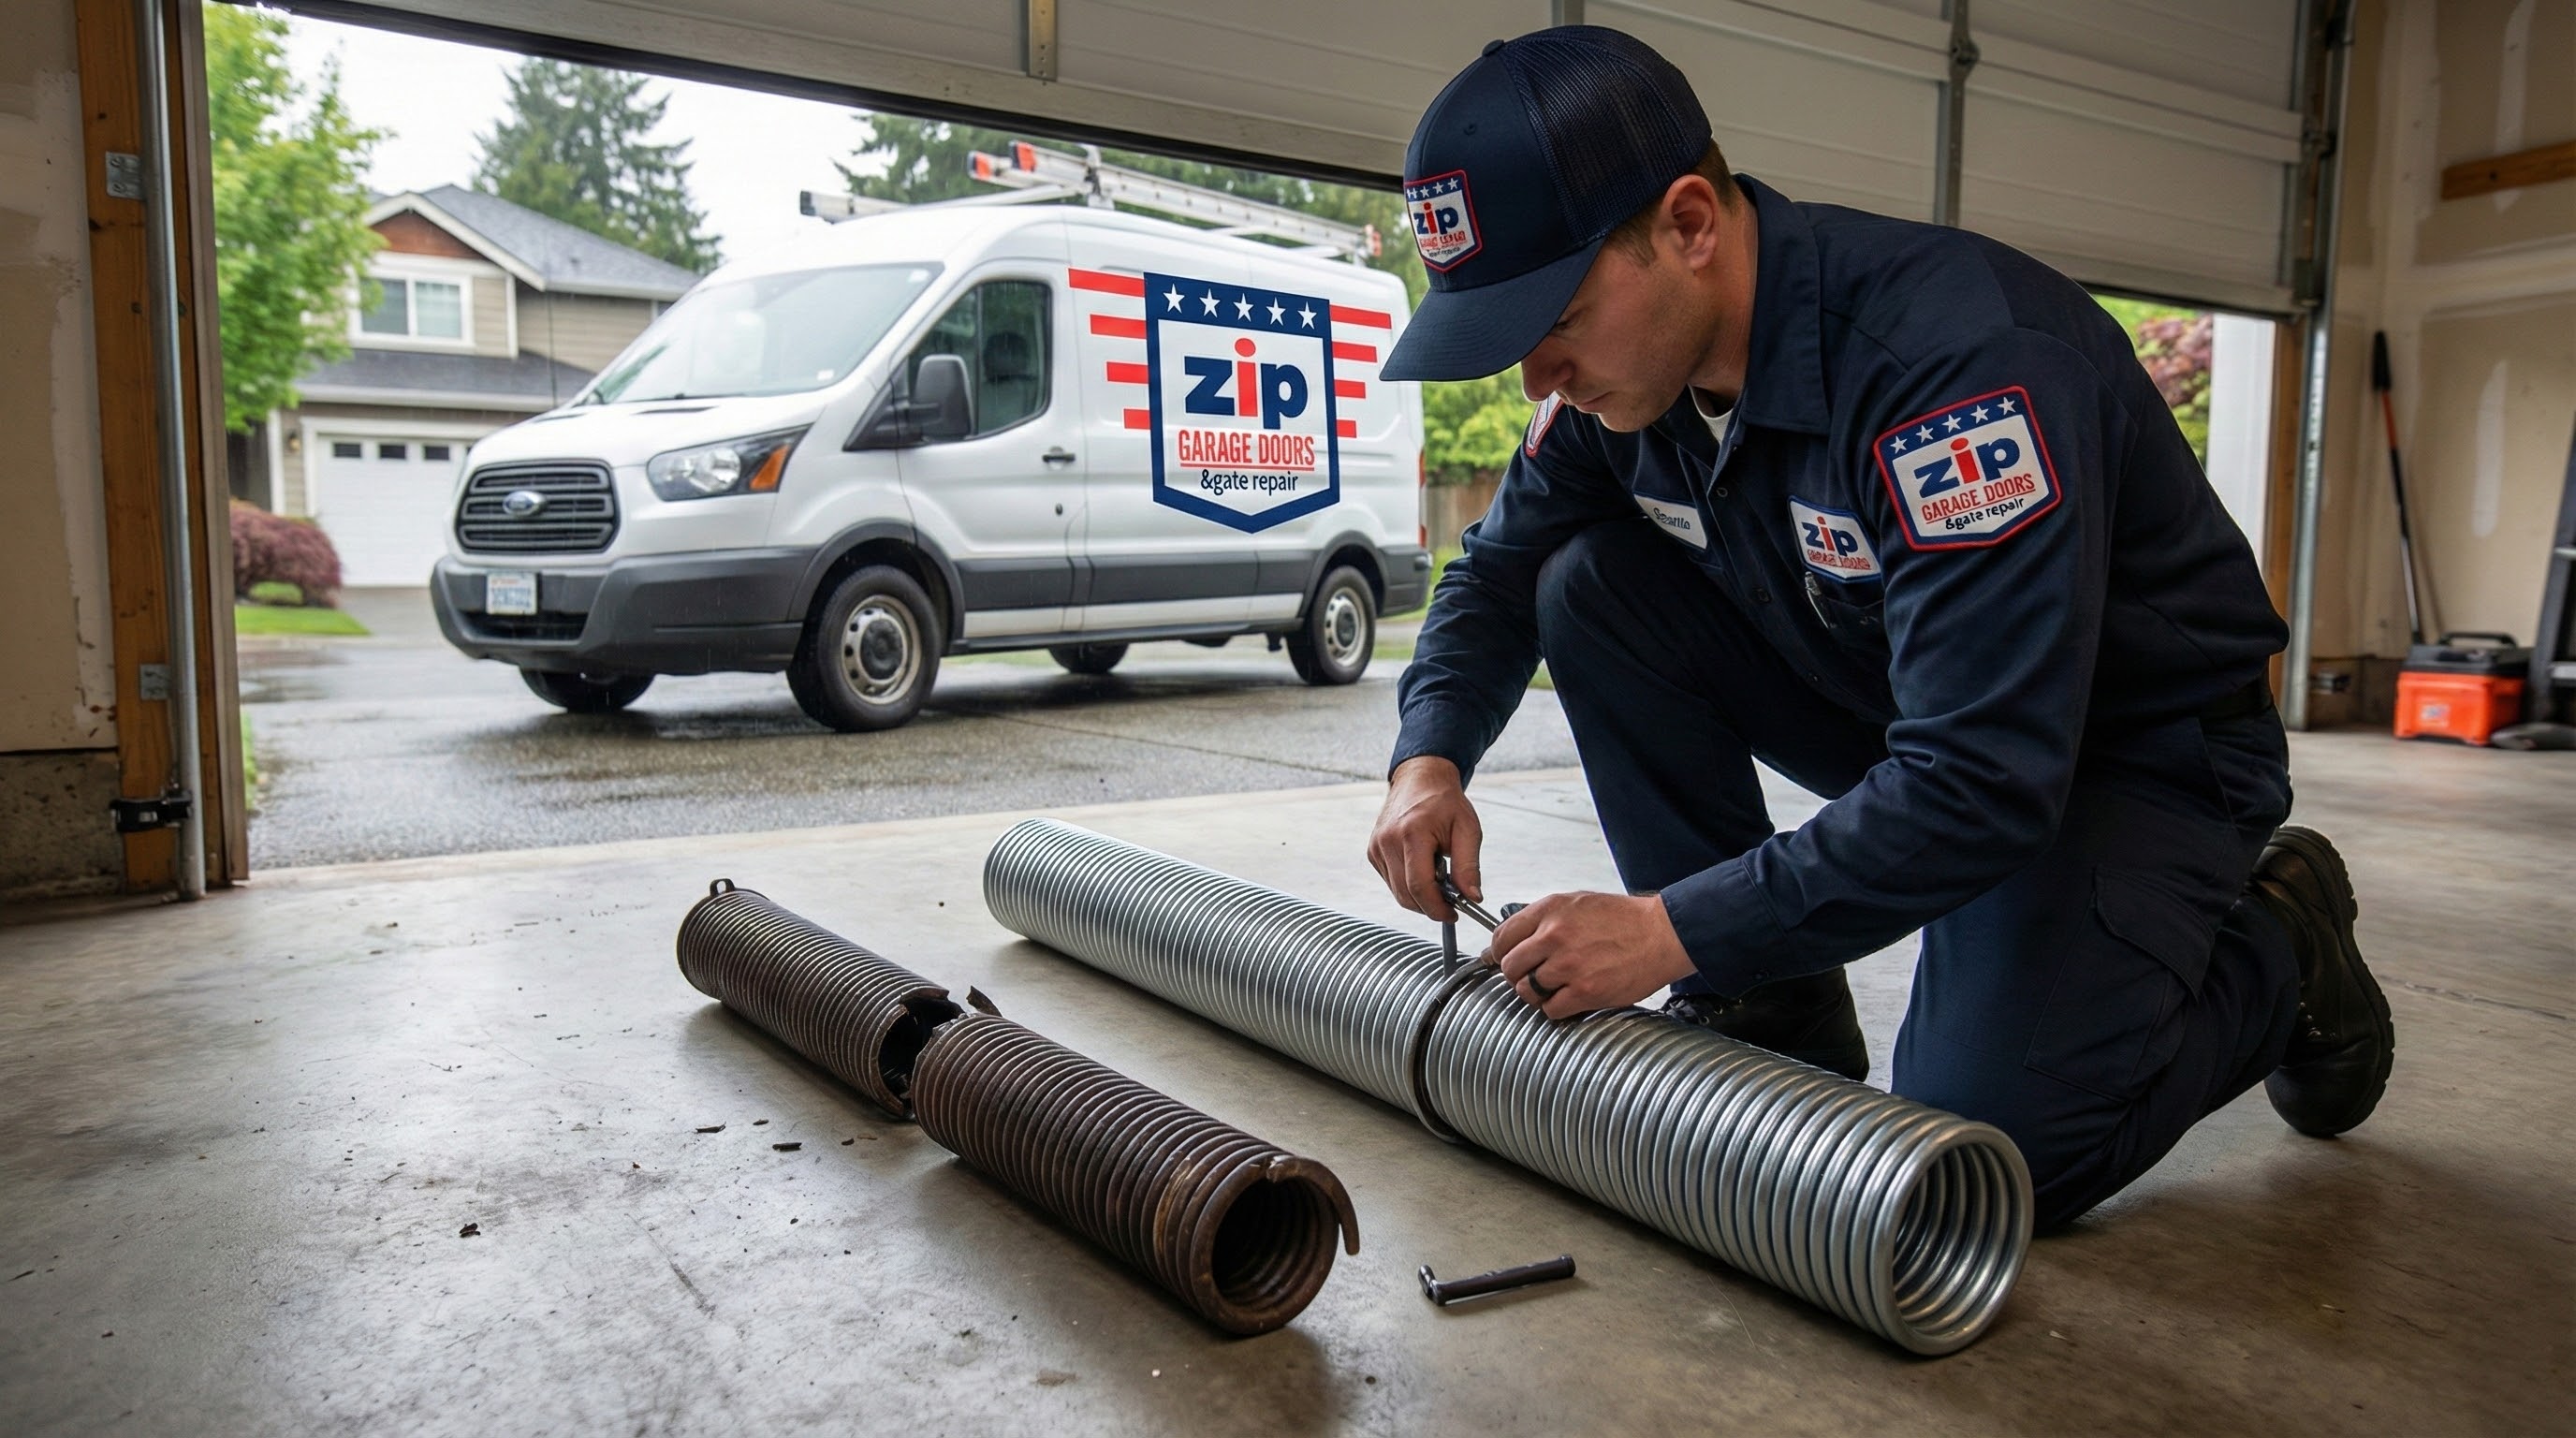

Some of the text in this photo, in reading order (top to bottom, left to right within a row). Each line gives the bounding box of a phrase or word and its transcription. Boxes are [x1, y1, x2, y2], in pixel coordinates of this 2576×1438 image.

[1413, 202, 1458, 234] zip
[1184, 338, 1308, 430] zip
[1178, 430, 1315, 465] GARAGE DOORS
[1913, 437, 2020, 498] zip
[1200, 469, 1298, 496] &gate repair
[1922, 473, 2035, 521] GARAGE DOORS
[1801, 516, 1859, 557] zip
